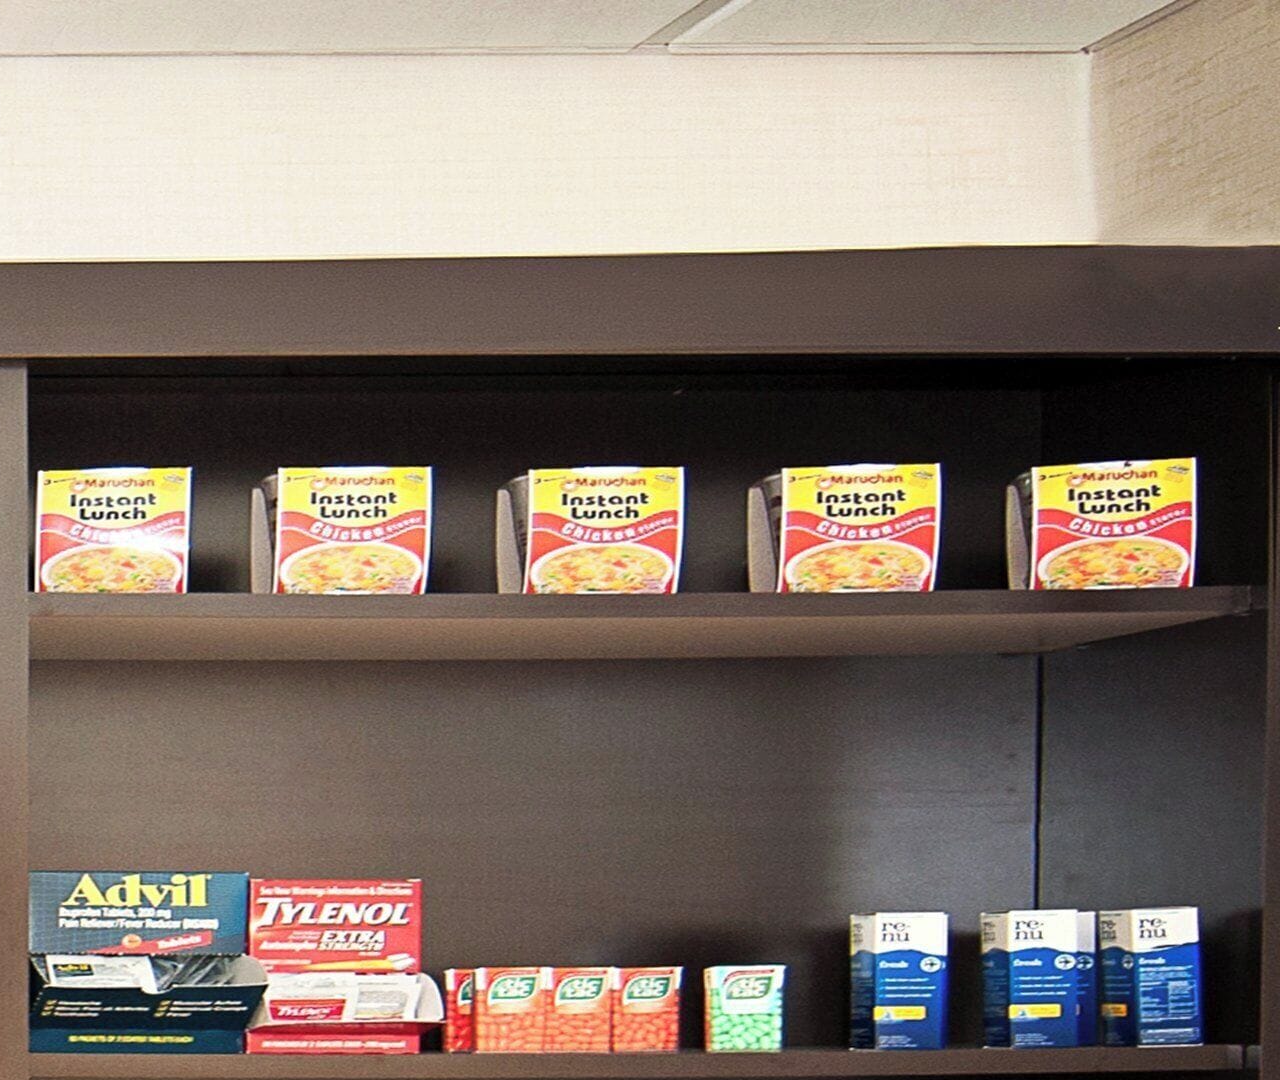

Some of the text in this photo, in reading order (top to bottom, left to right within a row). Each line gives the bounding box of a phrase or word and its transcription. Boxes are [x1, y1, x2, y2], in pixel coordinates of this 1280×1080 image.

[325, 475, 396, 488] Maruchan
[576, 475, 647, 488] Maruchan
[831, 473, 904, 486] Maruchan
[1082, 467, 1158, 482] Maruchan
[85, 476, 156, 489] Maruchan
[69, 493, 157, 508] Instant
[310, 491, 398, 507] Instant
[561, 492, 649, 507] Instant
[816, 489, 907, 506] Instant
[1067, 485, 1162, 503] Instant
[79, 506, 148, 521] Lunch
[319, 505, 388, 519] Lunch
[571, 505, 640, 520] Lunch
[826, 503, 897, 519] Lunch
[1078, 500, 1152, 515] Lunch
[309, 520, 384, 543] Chicken
[562, 521, 636, 544] Chicken
[817, 519, 893, 542] Chicken
[1069, 517, 1147, 538] Chicken
[61, 873, 209, 908] Advil
[255, 897, 412, 925] TYLENOL
[321, 930, 386, 944] EXTRA
[881, 931, 911, 943] nu
[1013, 930, 1045, 941] nu
[1139, 928, 1168, 939] nu
[505, 979, 532, 988] tic
[572, 979, 600, 988] tic
[639, 979, 667, 988] tic
[498, 988, 525, 998] tac
[565, 988, 595, 998] tac
[632, 988, 660, 998] tac
